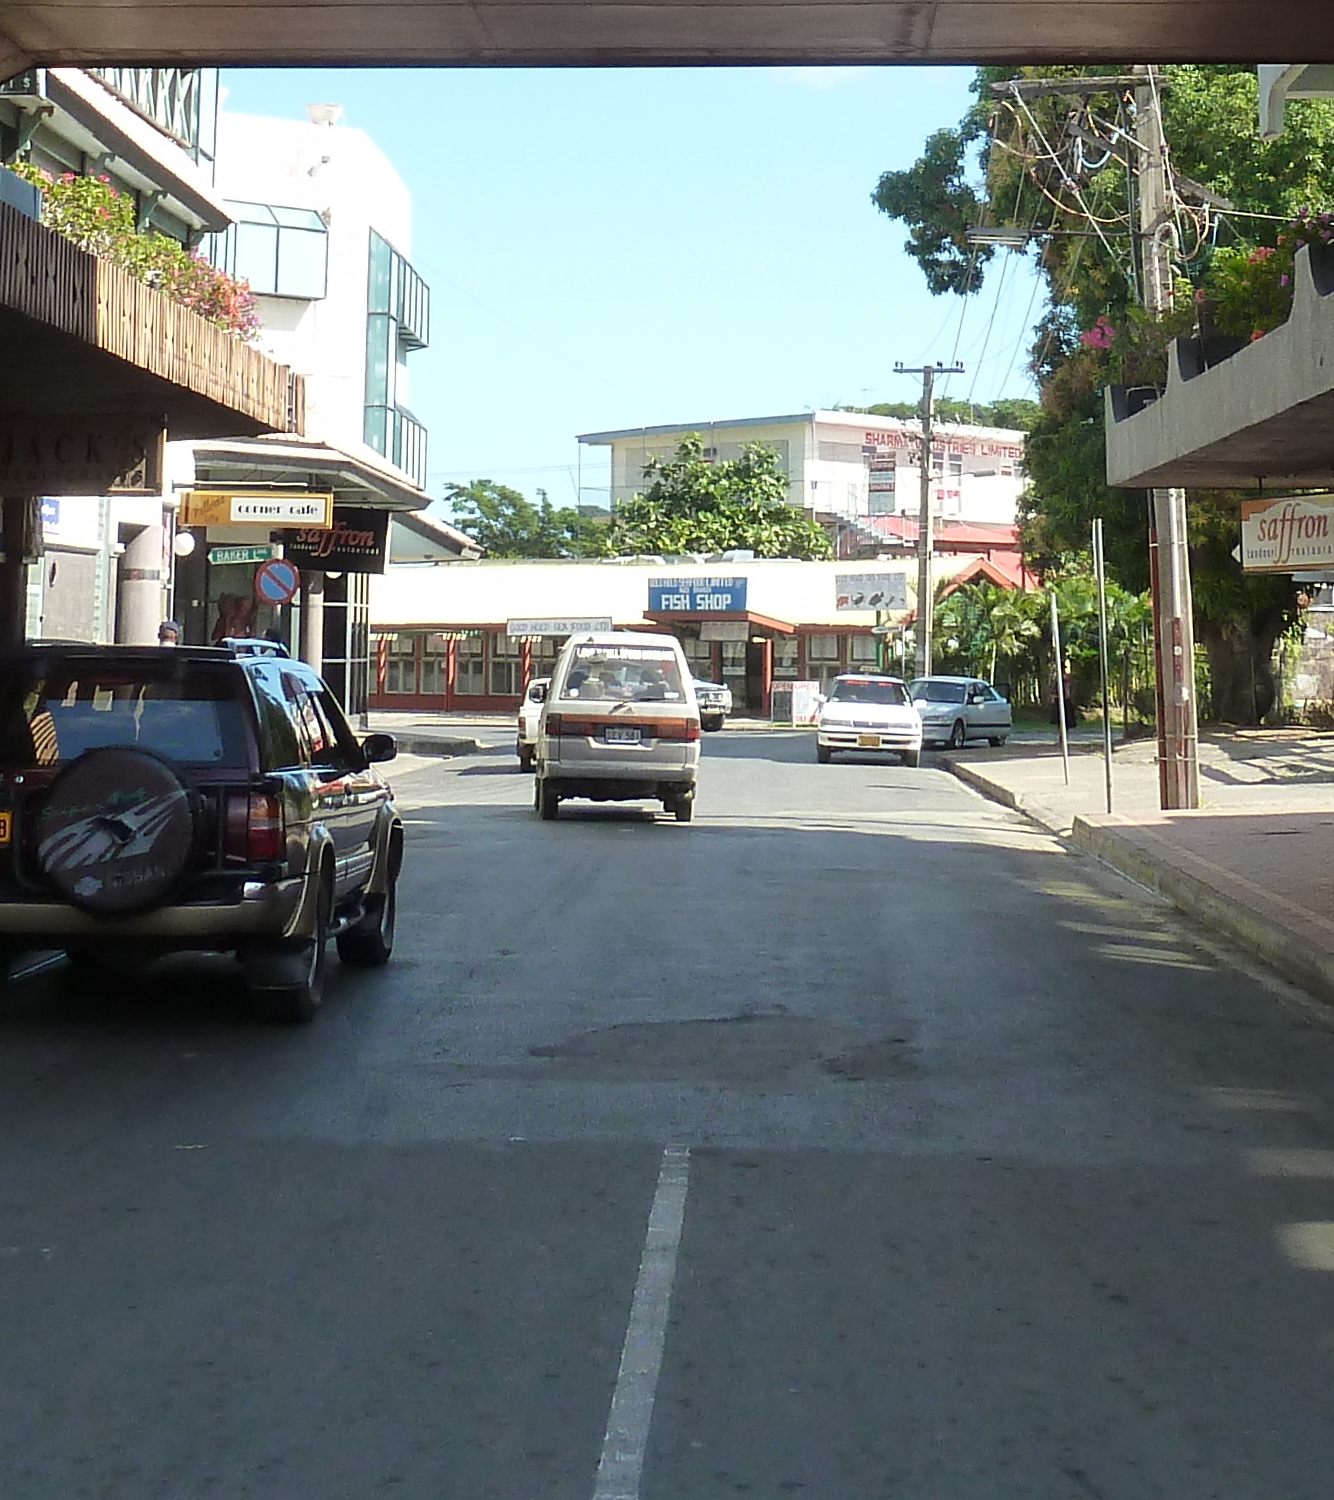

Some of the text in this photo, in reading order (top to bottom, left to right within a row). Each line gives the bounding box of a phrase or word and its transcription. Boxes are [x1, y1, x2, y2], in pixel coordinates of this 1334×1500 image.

[981, 444, 1023, 458] LIMITED
[238, 504, 281, 514] corner
[289, 504, 319, 516] cafe
[296, 521, 375, 557] saffron
[1258, 502, 1329, 564] saffron
[217, 549, 249, 561] BAKER
[661, 594, 732, 610] FISH SHOP
